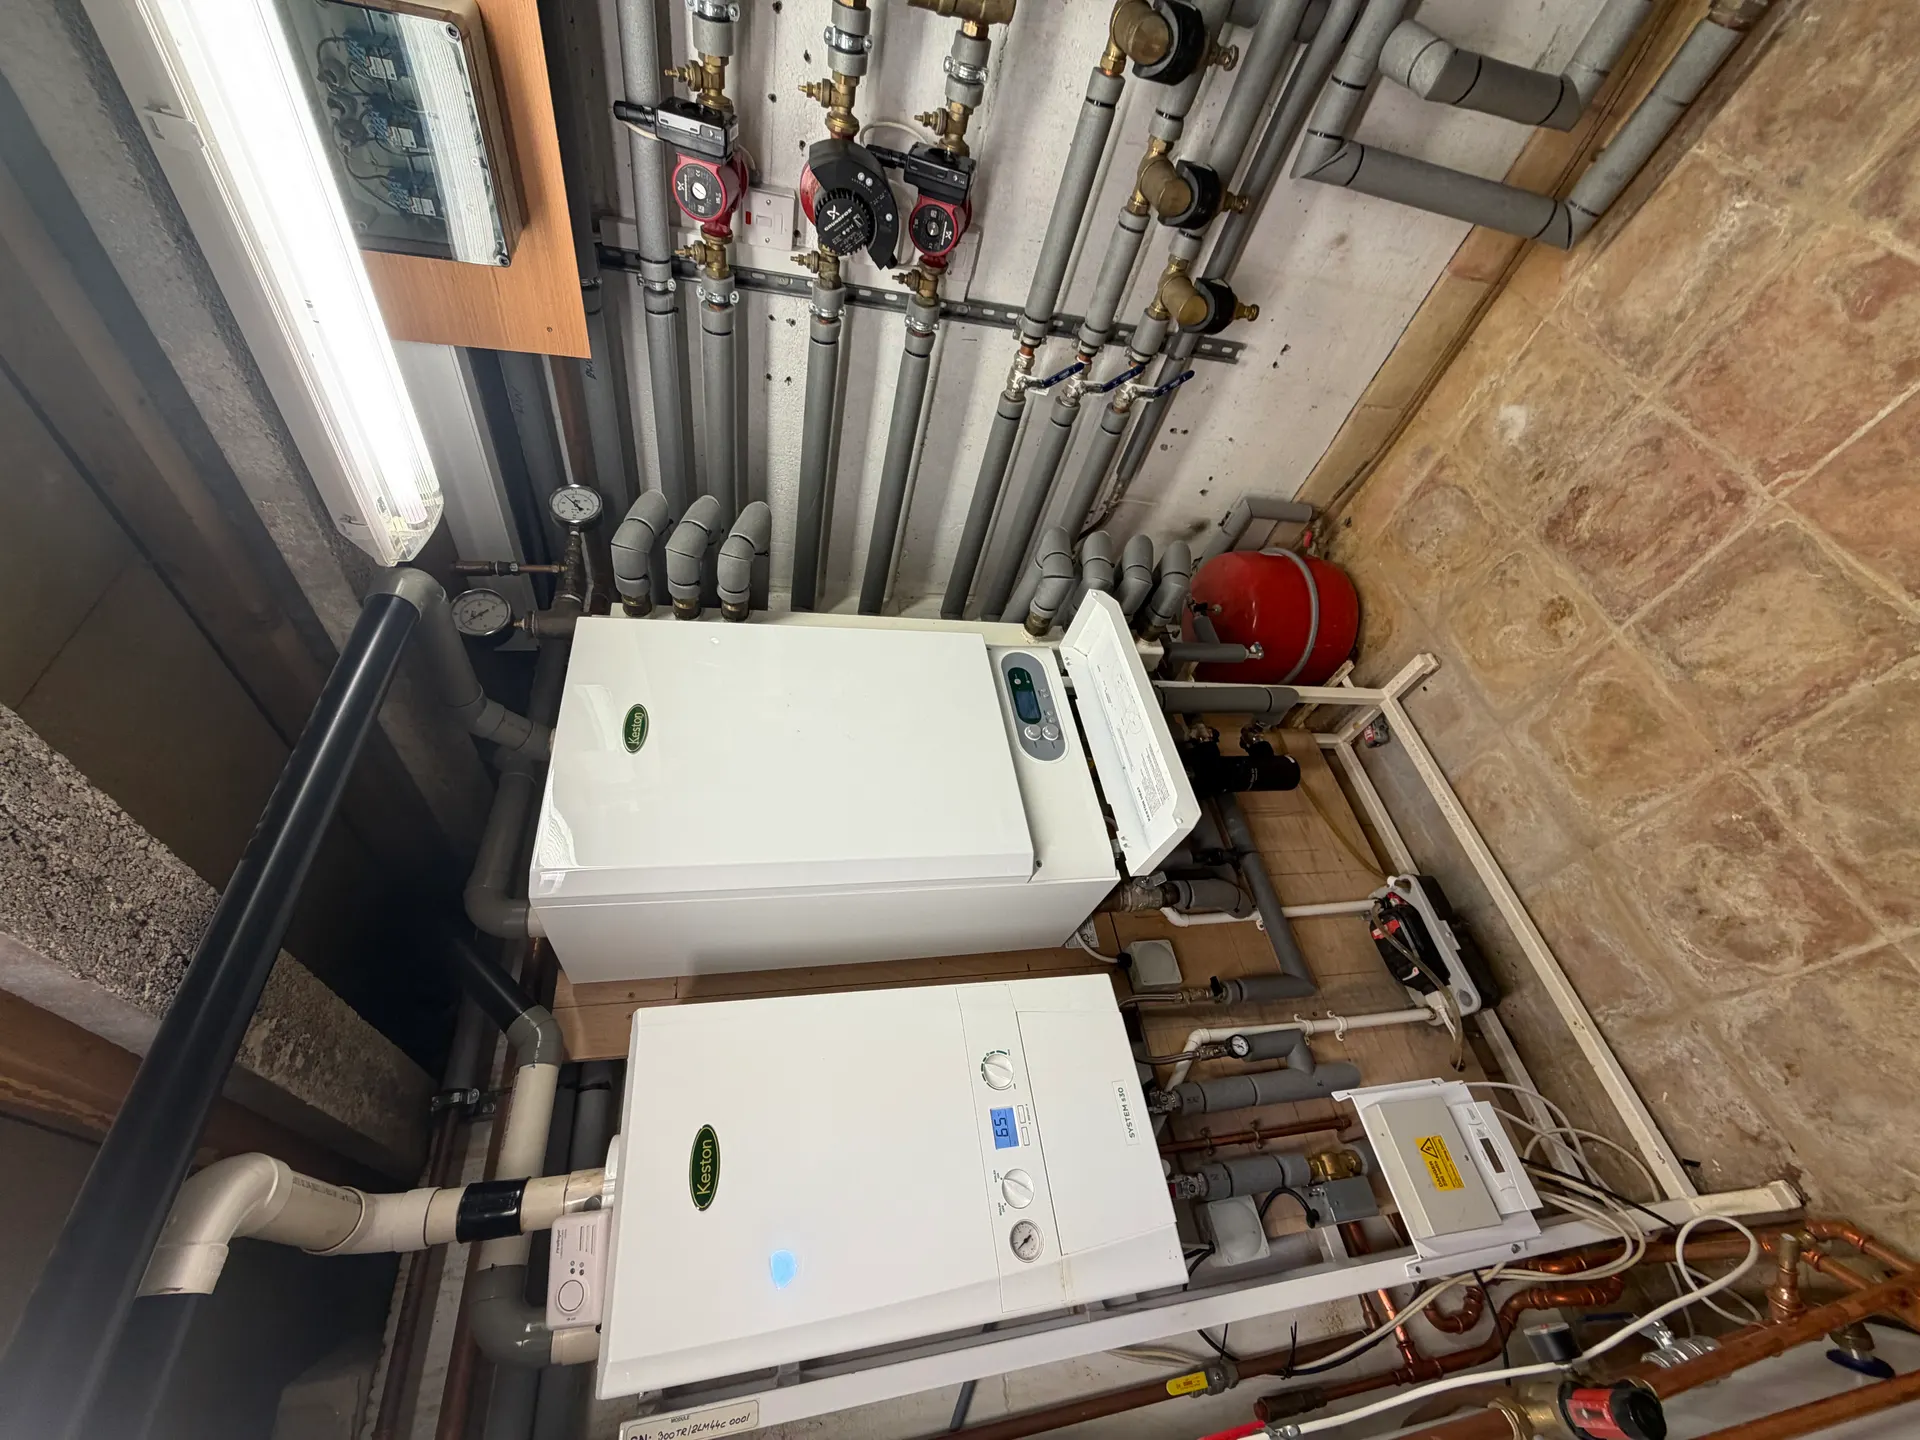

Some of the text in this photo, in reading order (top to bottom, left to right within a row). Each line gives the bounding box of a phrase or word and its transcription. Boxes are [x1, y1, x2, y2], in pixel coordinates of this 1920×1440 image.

[824, 208, 852, 231] GRUNDFOS
[628, 712, 645, 745] Keston
[994, 1117, 1008, 1137] 65
[1121, 1104, 1135, 1138] SYSTEM
[697, 1138, 713, 1196] Keston
[1429, 1161, 1443, 1187] DANGER
[670, 1415, 690, 1423] MODULE
